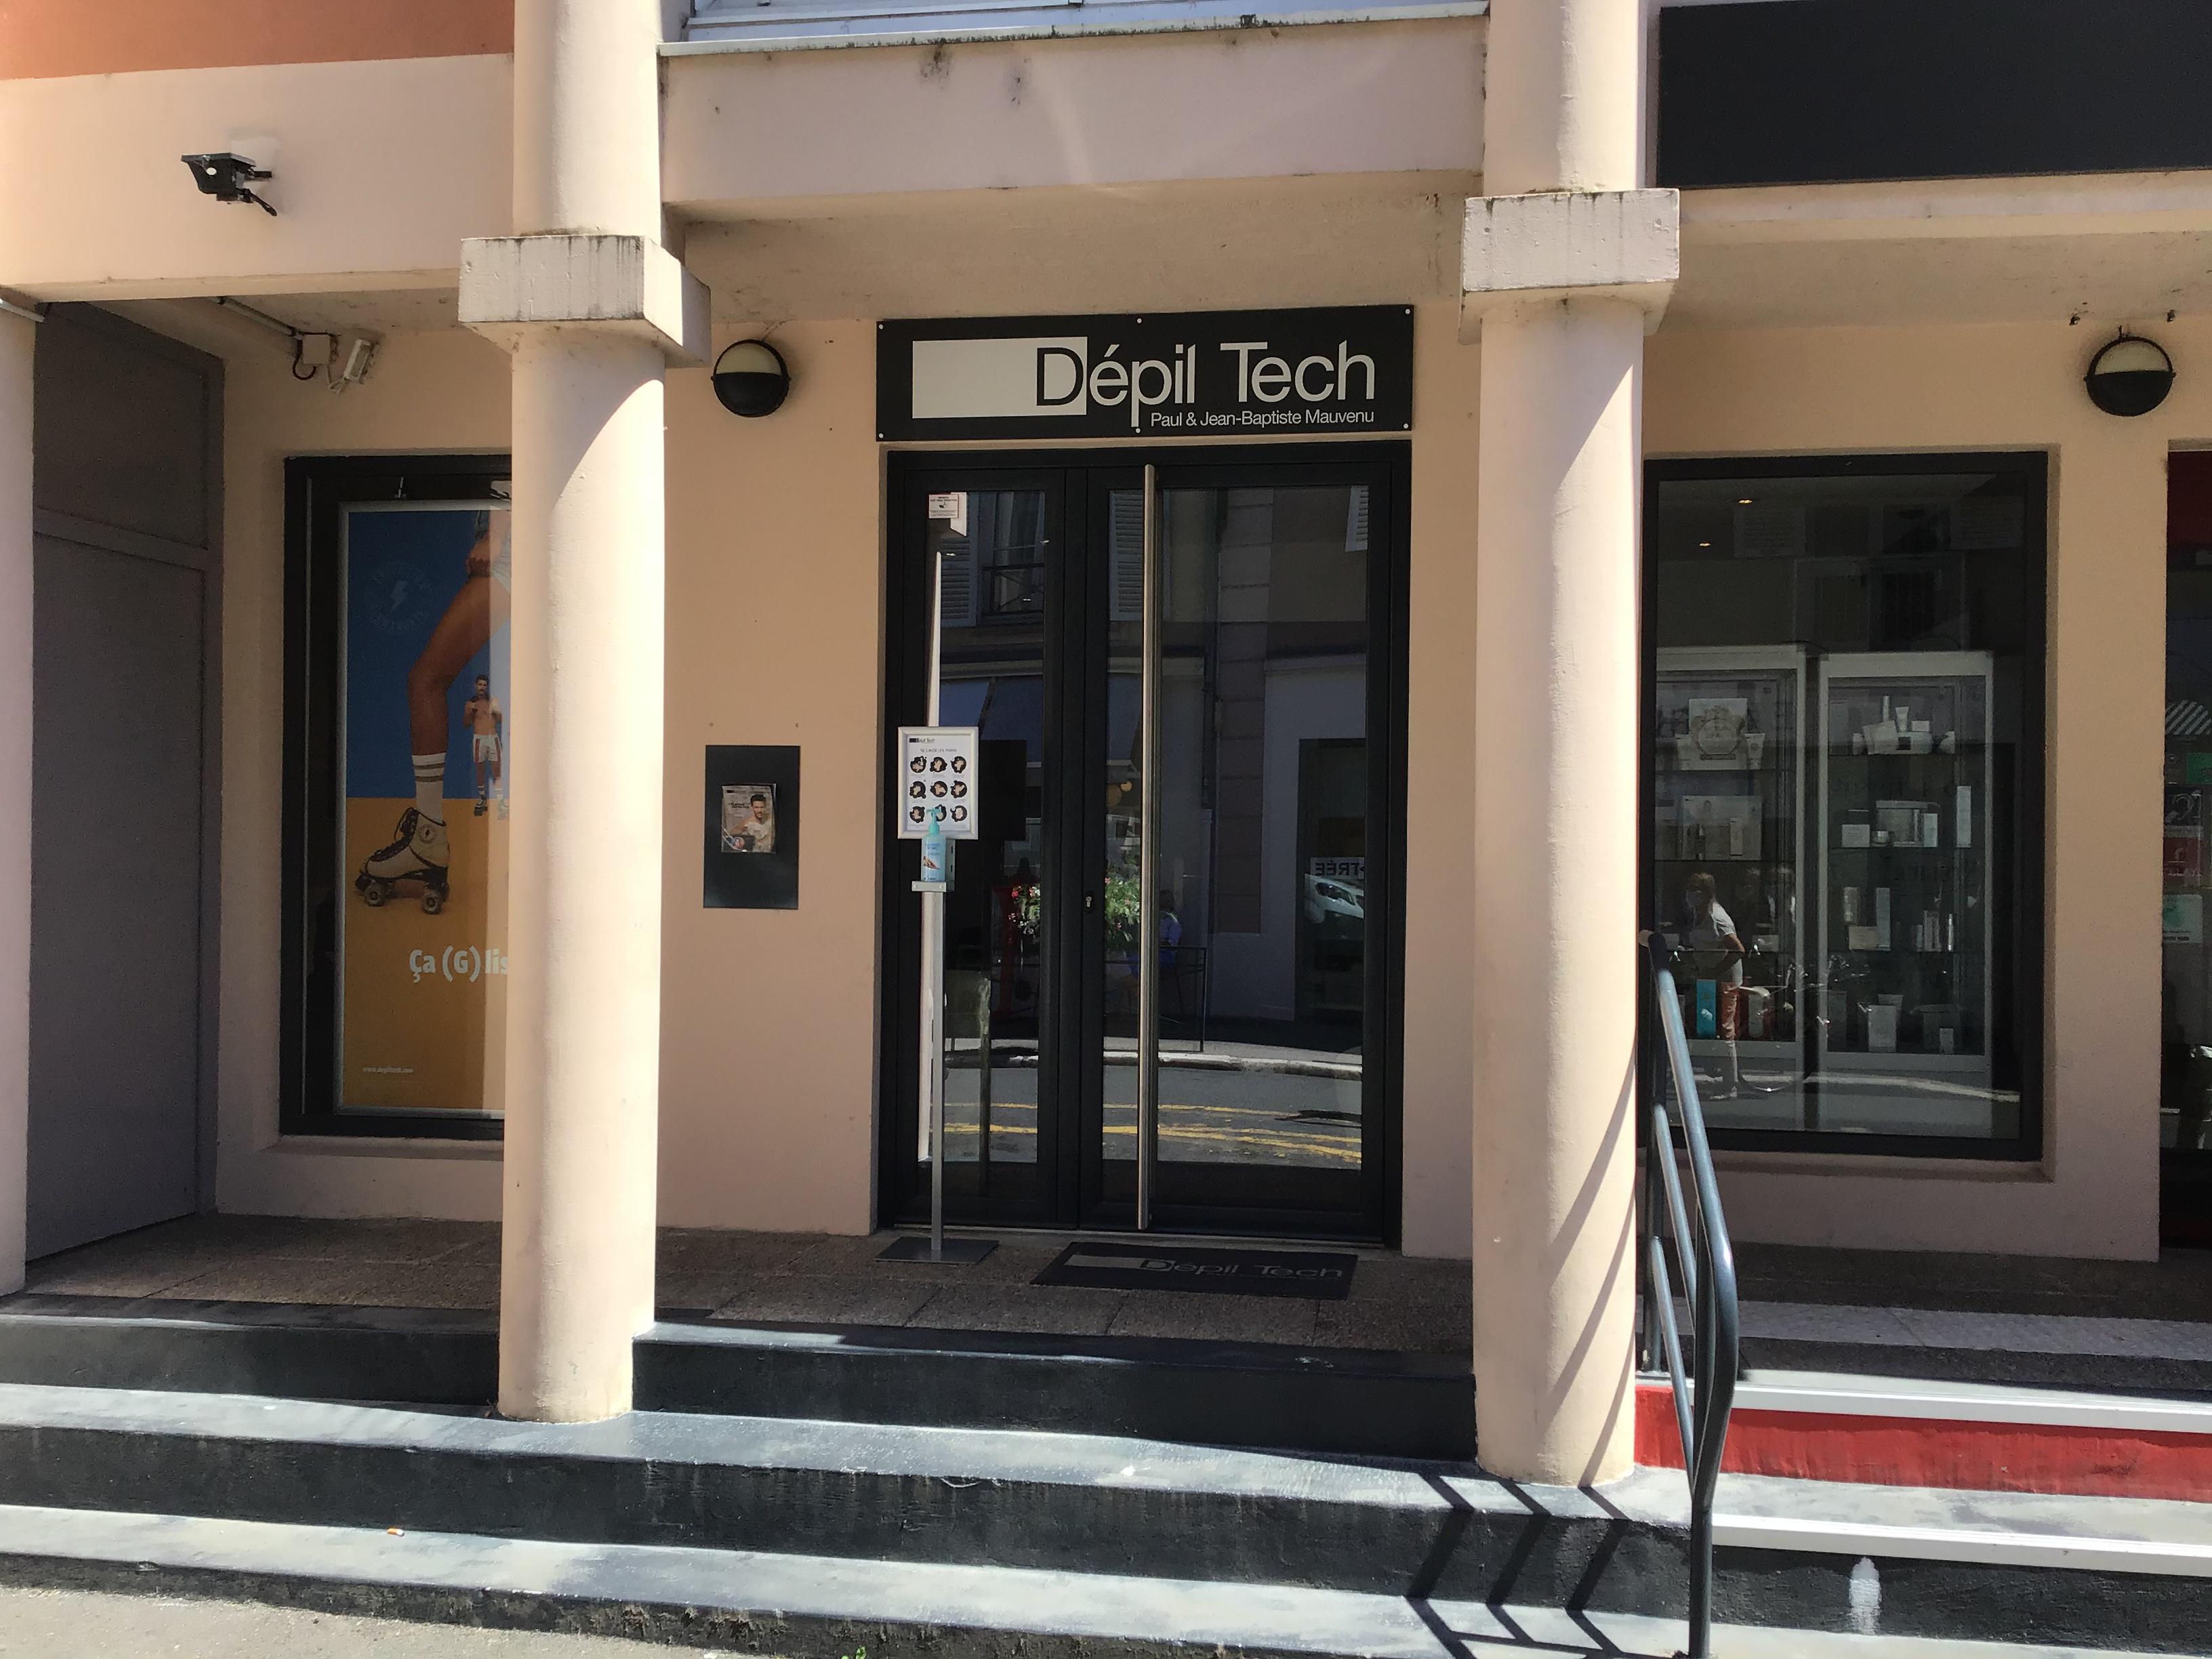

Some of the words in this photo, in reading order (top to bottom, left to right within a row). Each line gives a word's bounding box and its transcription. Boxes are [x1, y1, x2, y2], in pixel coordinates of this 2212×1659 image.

[1036, 343, 1195, 428] Dépil
[1221, 340, 1375, 403] Tech
[1150, 411, 1182, 427] Paul
[1186, 412, 1197, 426] &
[1200, 410, 1302, 428] Jean-Baptiste
[1305, 409, 1375, 425] Mauvenu
[409, 949, 436, 983] Ça
[1258, 1265, 1343, 1277] Tech
